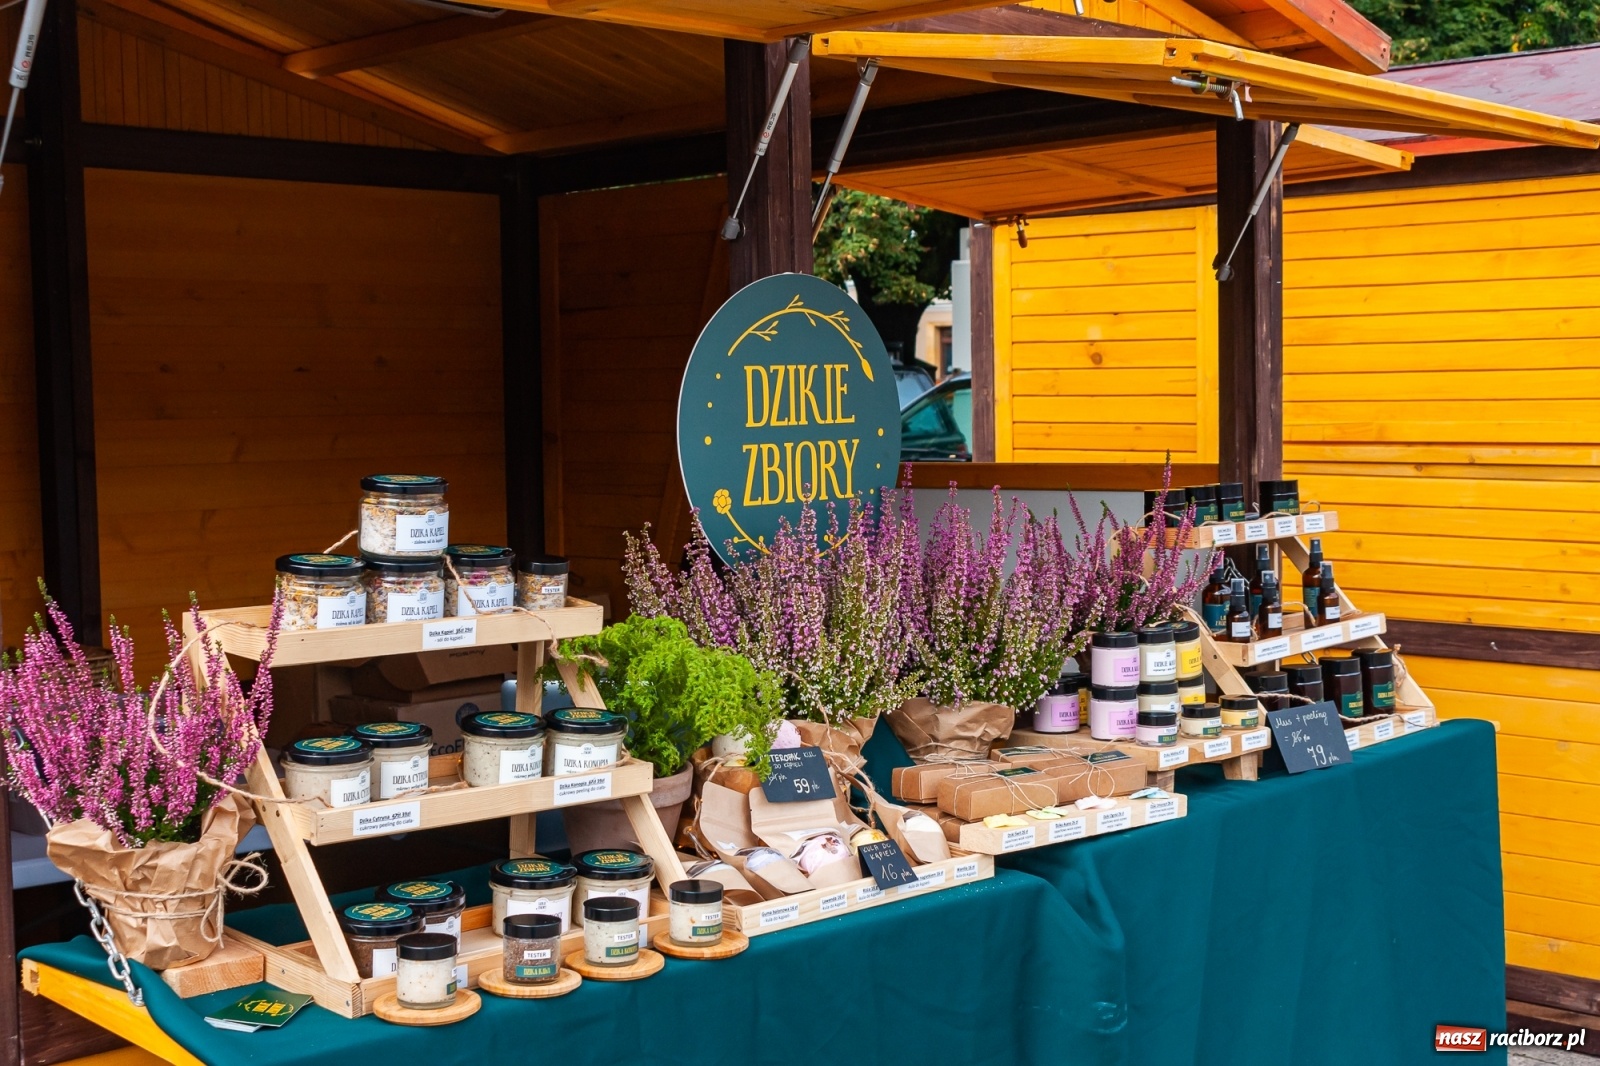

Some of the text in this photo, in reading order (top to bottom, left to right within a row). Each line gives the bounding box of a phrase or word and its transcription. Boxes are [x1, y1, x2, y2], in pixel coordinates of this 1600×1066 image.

[743, 364, 856, 428] DZIKIE
[742, 438, 860, 507] ZBIORY
[410, 528, 429, 538] DZIKA
[332, 609, 350, 620] DZIKA
[401, 606, 420, 616] DZIKA
[1275, 717, 1293, 729] Mus
[1302, 709, 1329, 727] peeling
[1306, 744, 1327, 767] 79
[512, 763, 529, 773] DZIKA
[564, 758, 609, 769] DZIKA KONOPIA
[392, 774, 412, 785] DZIKA
[793, 778, 811, 794] 59
[343, 791, 360, 803] DZIKA
[863, 845, 880, 853] KULA
[869, 849, 897, 861] KĄPIELI
[881, 863, 898, 882] 16
[617, 933, 634, 941] TESTER
